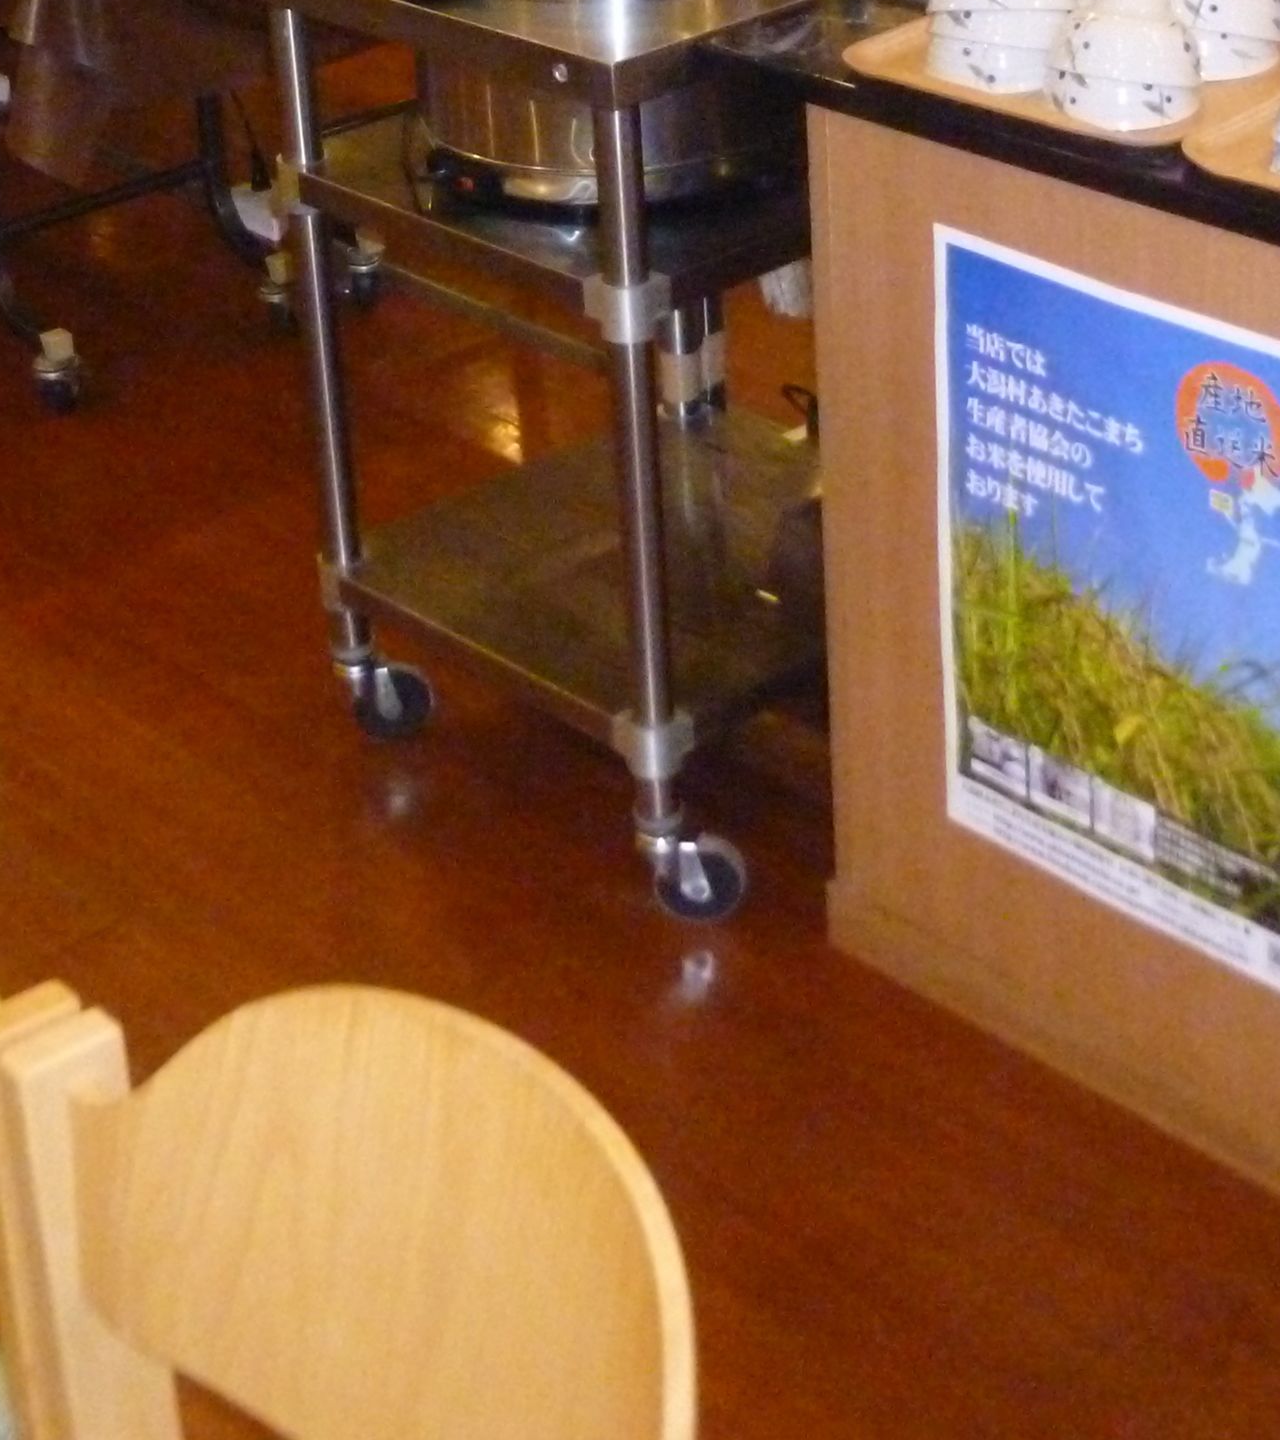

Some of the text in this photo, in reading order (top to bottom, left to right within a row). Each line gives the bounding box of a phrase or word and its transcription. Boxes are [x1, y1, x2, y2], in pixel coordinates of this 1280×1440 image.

[966, 324, 1046, 378] 当店では
[1201, 372, 1266, 424] 産地
[965, 432, 1106, 513] お米を使用して
[965, 468, 1039, 518] おります
